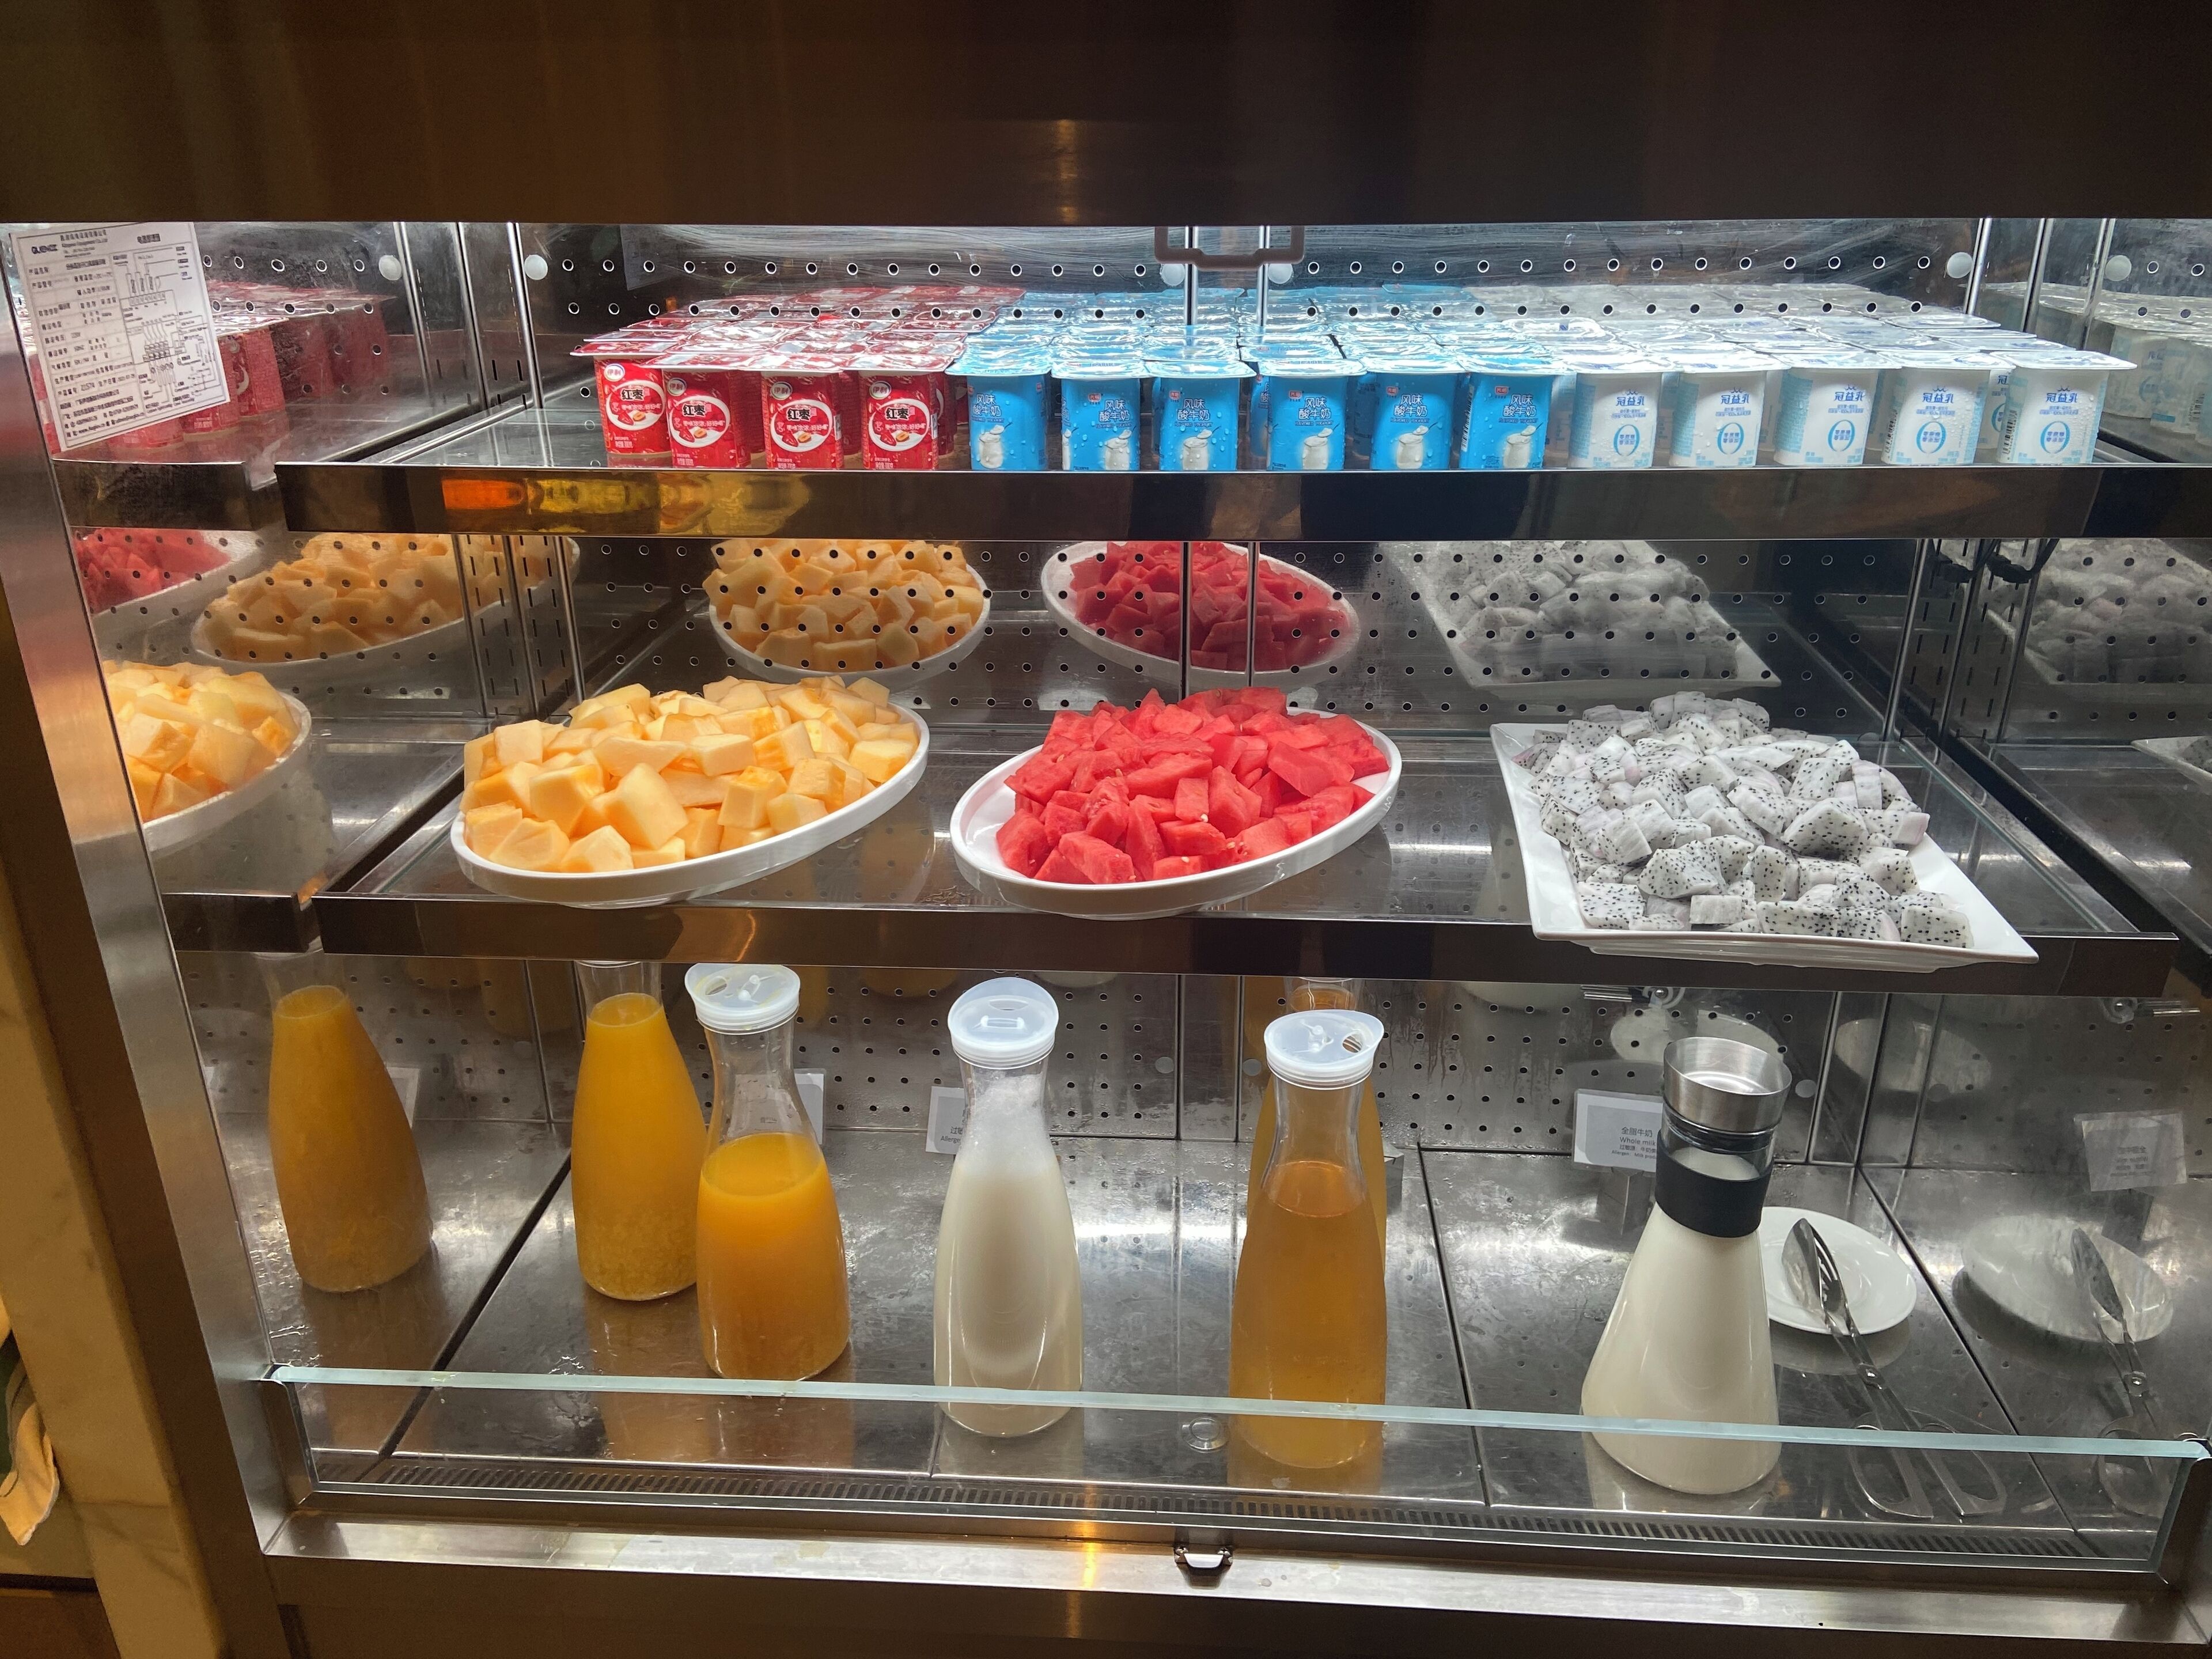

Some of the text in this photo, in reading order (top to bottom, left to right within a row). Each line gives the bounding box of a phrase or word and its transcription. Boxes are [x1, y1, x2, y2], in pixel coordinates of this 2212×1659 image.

[622, 389, 644, 400] 红枣
[976, 394, 996, 405] 风味
[1401, 394, 1423, 405] 风味
[1510, 394, 1533, 405] 风味
[1721, 393, 1749, 404] 冠益乳
[1834, 391, 1866, 402] 冠益乳
[1922, 392, 1954, 404] 冠益乳
[2046, 392, 2078, 403] 冠益乳
[1104, 400, 1126, 411] 风味
[1183, 398, 1205, 409] 风味
[1305, 397, 1327, 408] 风味
[1616, 396, 1645, 407] 冠益乳
[683, 404, 706, 416] 红枣
[787, 408, 810, 421] 红枣
[886, 407, 909, 419] 红枣
[972, 405, 1001, 416] 酸牛奶
[1177, 410, 1210, 421] 酸牛奶
[1298, 408, 1331, 419] 酸牛奶
[1394, 406, 1427, 417] 酸牛奶
[1503, 406, 1537, 417] 酸牛奶
[1099, 410, 1130, 422] 酸牛奶
[1622, 1127, 1653, 1137] 全脂牛奶
[941, 1135, 961, 1143] Allerge
